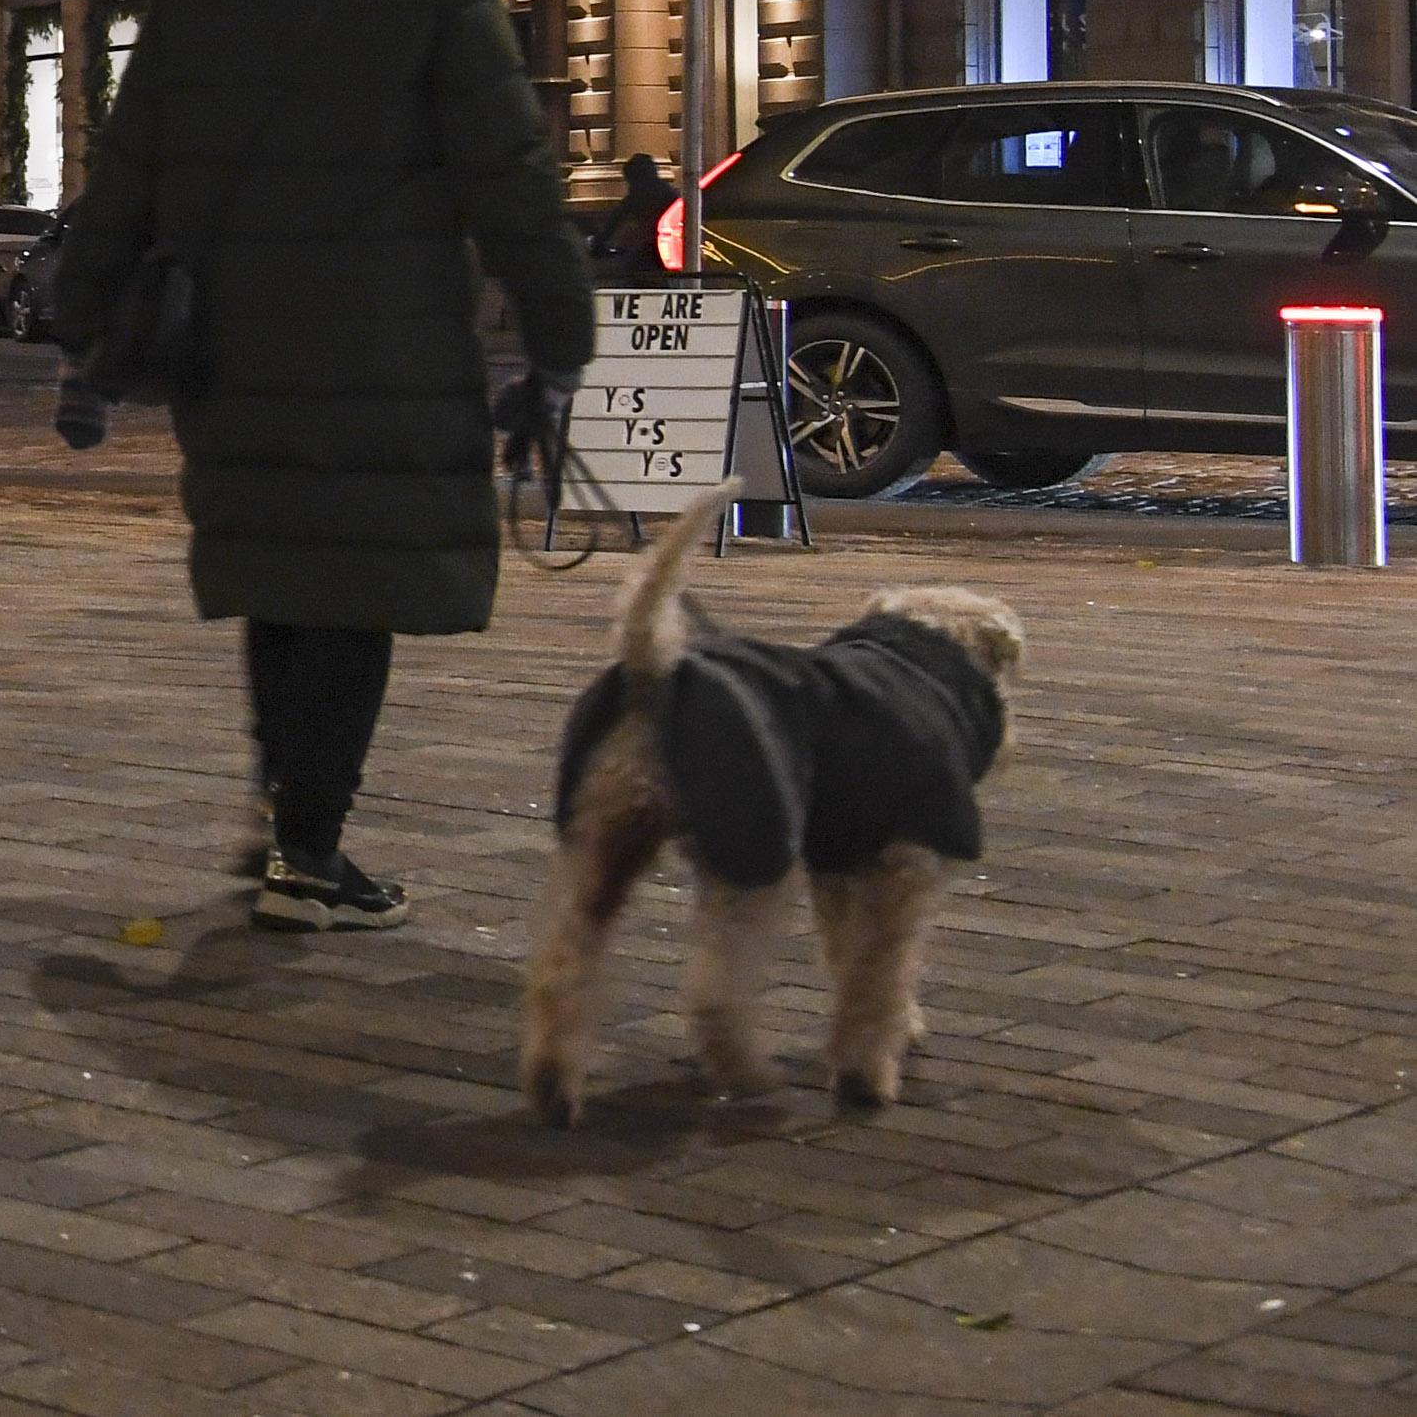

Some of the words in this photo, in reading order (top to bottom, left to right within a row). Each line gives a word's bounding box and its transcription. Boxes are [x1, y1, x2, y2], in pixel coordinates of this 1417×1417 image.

[613, 294, 640, 319] WE
[661, 294, 703, 319] ARE
[631, 325, 689, 351] OPEN
